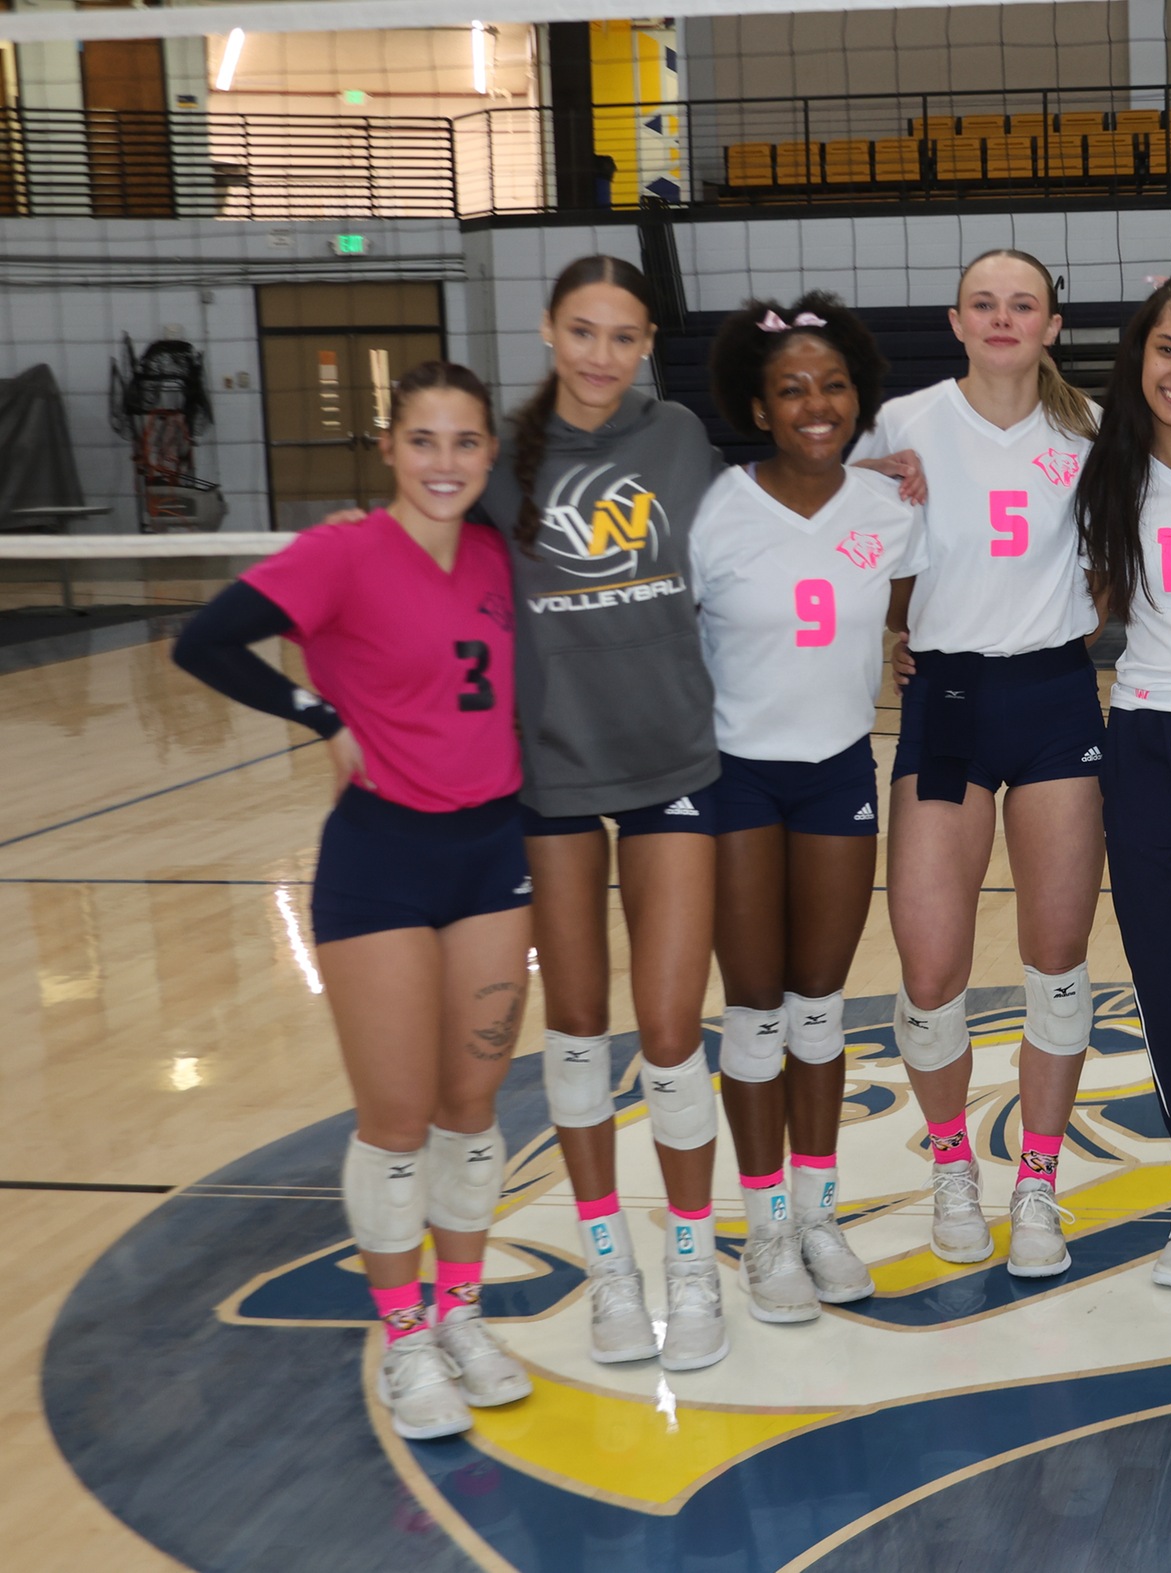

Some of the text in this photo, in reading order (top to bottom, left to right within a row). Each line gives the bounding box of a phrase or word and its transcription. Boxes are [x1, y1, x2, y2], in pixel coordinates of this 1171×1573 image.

[988, 489, 1030, 558] 5
[793, 577, 837, 648] 9
[454, 640, 495, 712] 3
